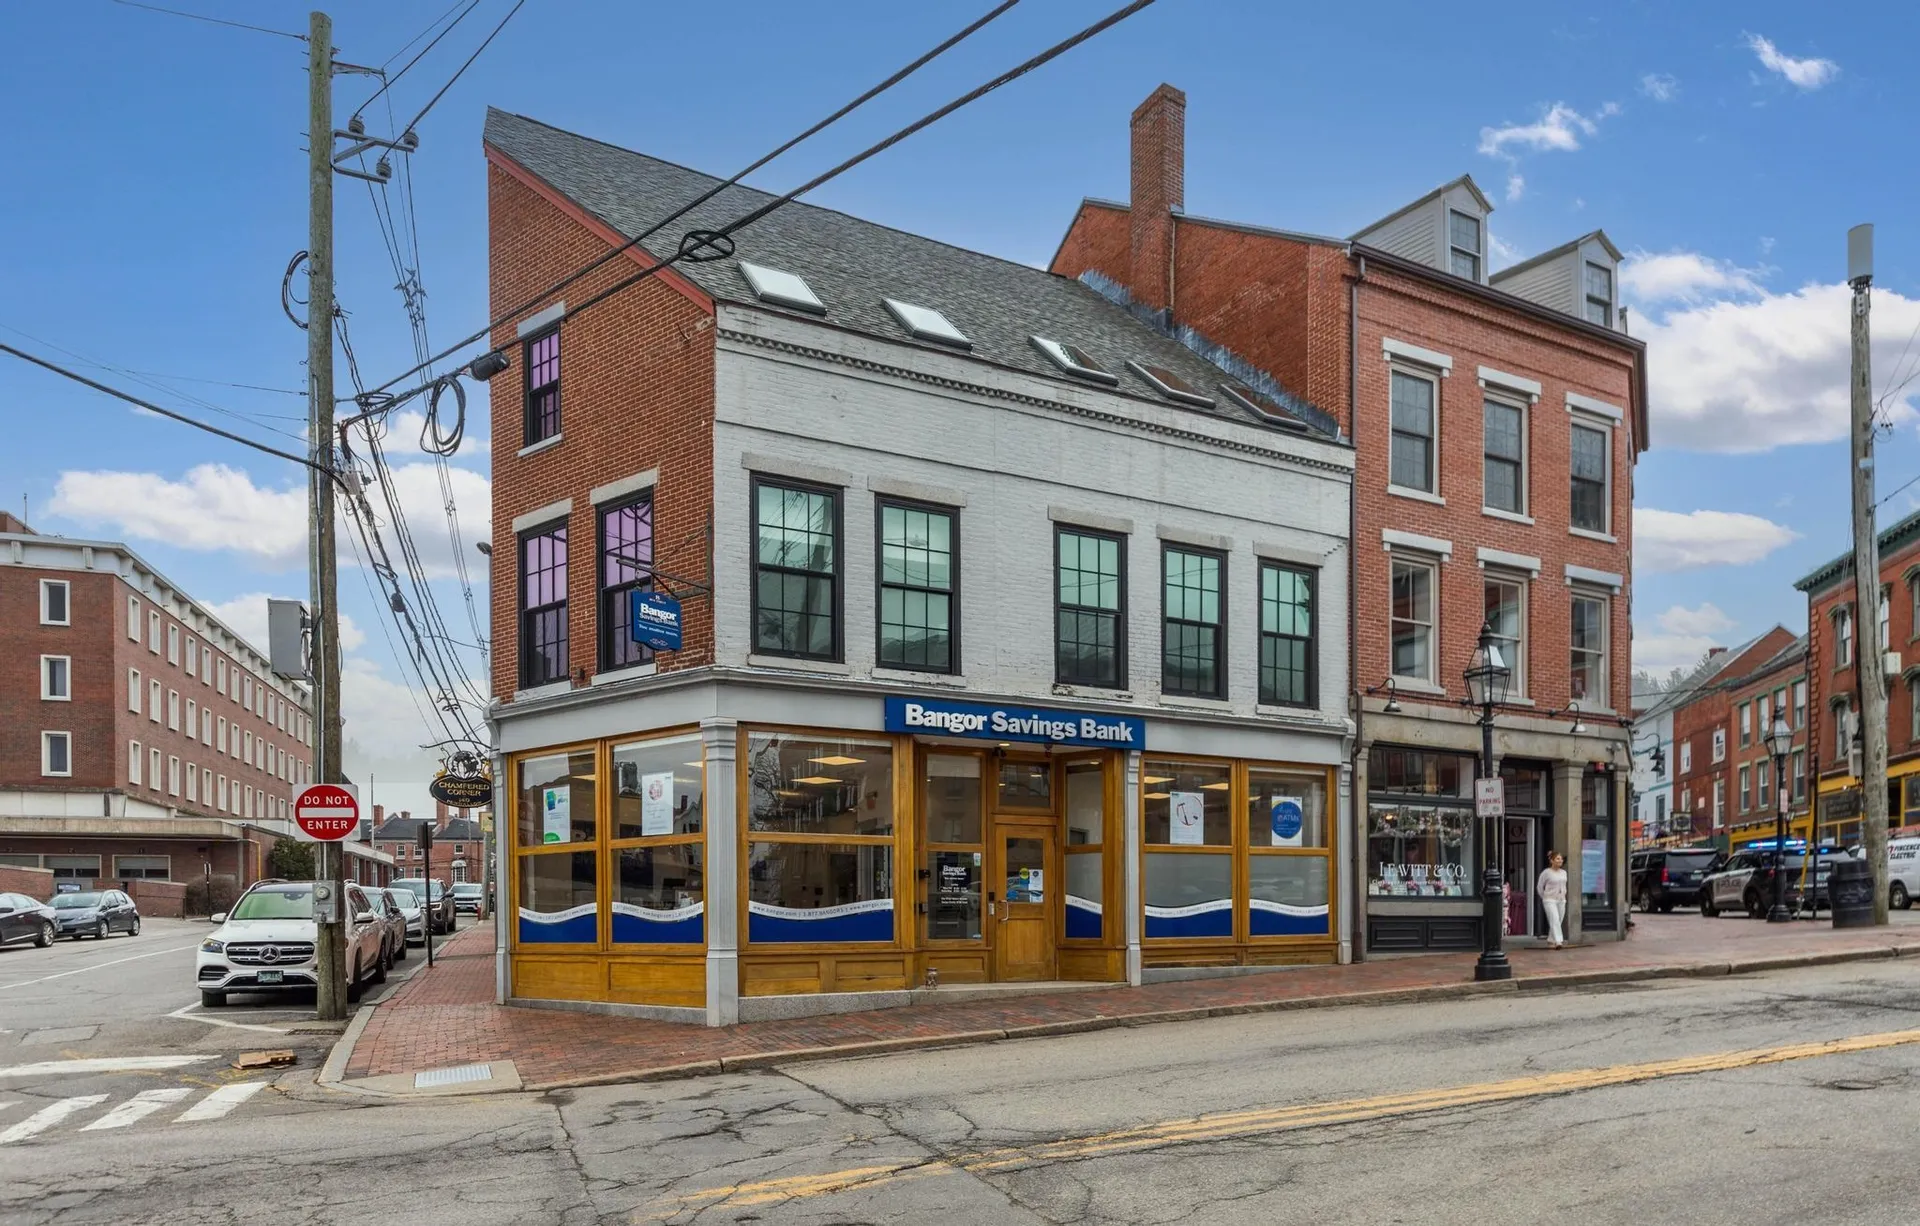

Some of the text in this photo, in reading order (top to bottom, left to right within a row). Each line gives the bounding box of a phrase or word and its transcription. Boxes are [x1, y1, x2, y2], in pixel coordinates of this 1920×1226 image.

[640, 603, 677, 620] Bangor
[905, 703, 1133, 742] Bangor Savings Bank
[438, 781, 490, 791] CHAMFERED
[447, 788, 481, 797] CORNER
[304, 795, 349, 805] DO NOT
[307, 820, 348, 830] ENTER
[943, 864, 966, 873] Bangor
[1379, 861, 1431, 877] LEAVITT
[1433, 863, 1444, 877] &
